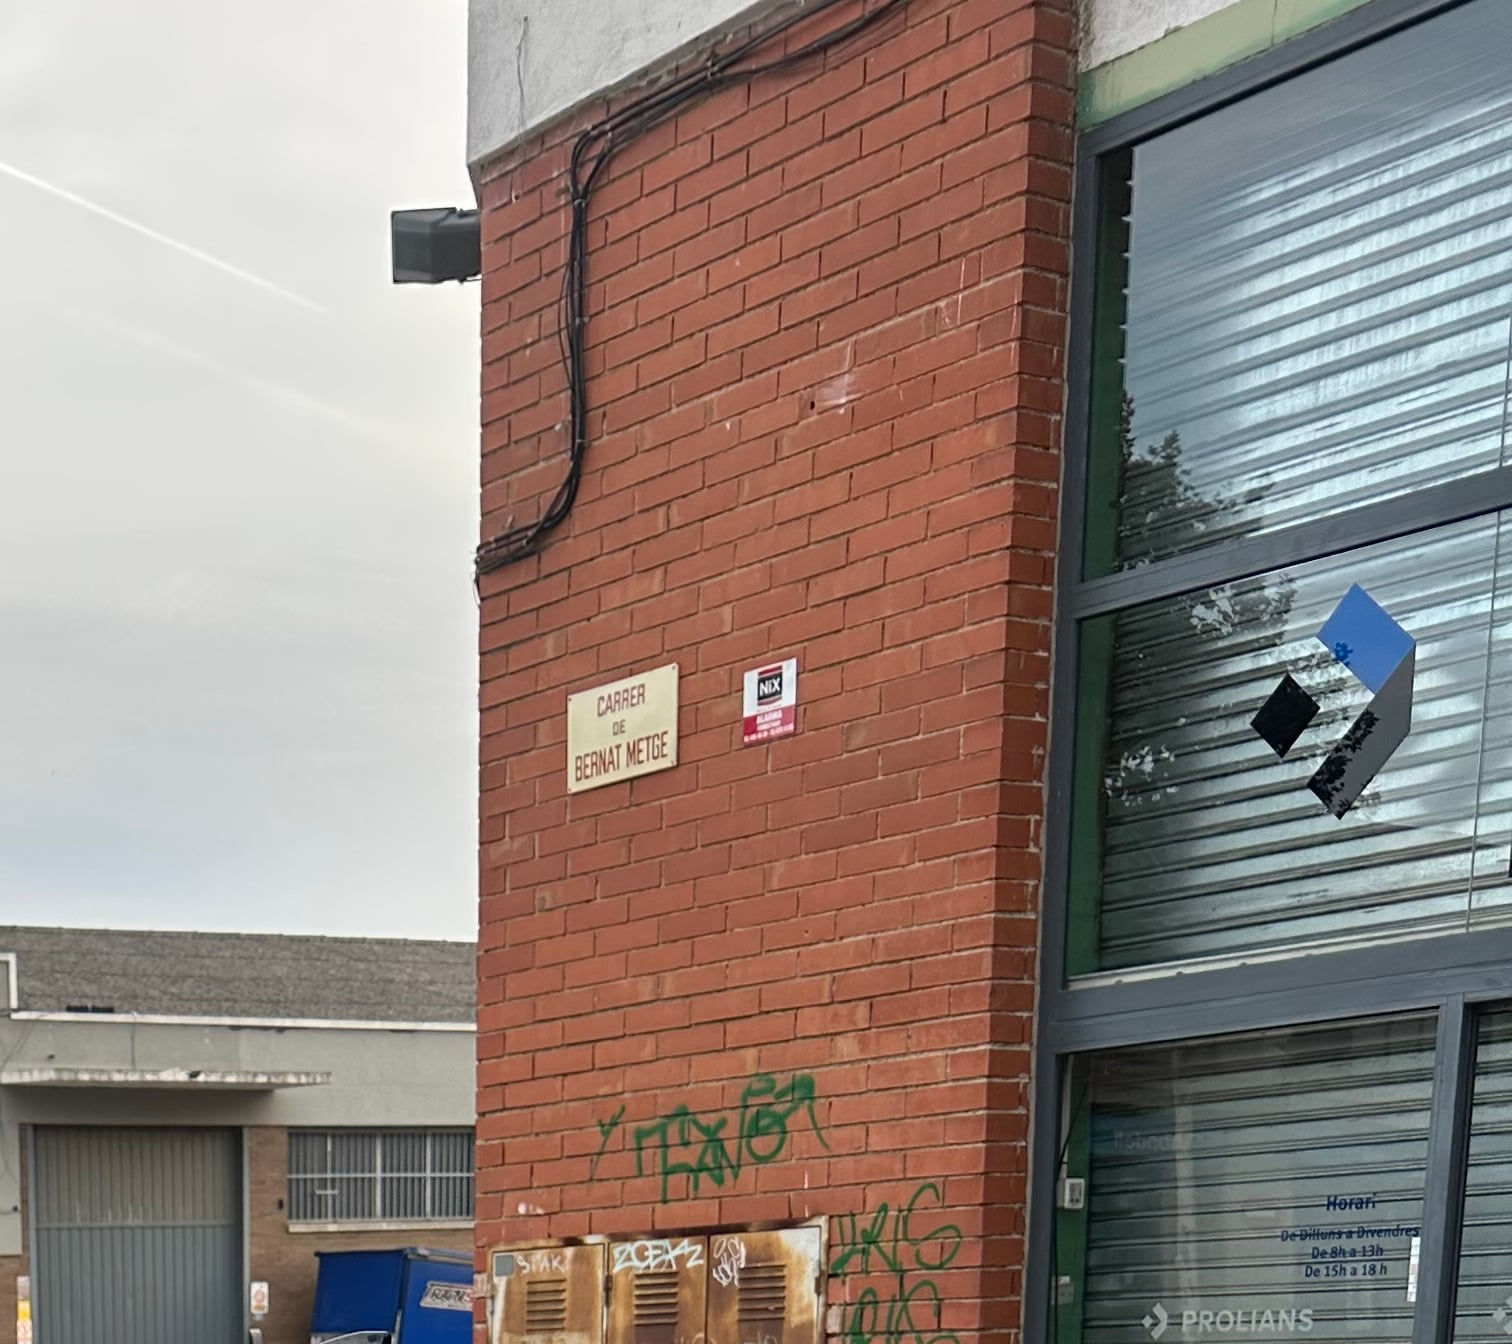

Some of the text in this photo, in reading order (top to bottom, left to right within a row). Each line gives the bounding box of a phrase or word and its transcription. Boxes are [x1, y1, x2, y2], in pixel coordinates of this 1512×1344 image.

[597, 683, 646, 717] CARRER
[612, 719, 626, 736] DE
[575, 731, 669, 782] BERNAT METGE
[1326, 1191, 1376, 1211] Horari
[1281, 1223, 1420, 1241] De Dilluns a Divendres
[1311, 1243, 1384, 1259] De 8h a 13h
[1305, 1263, 1387, 1277] De 15h a 18 h
[1181, 1306, 1314, 1333] PROLIANS
